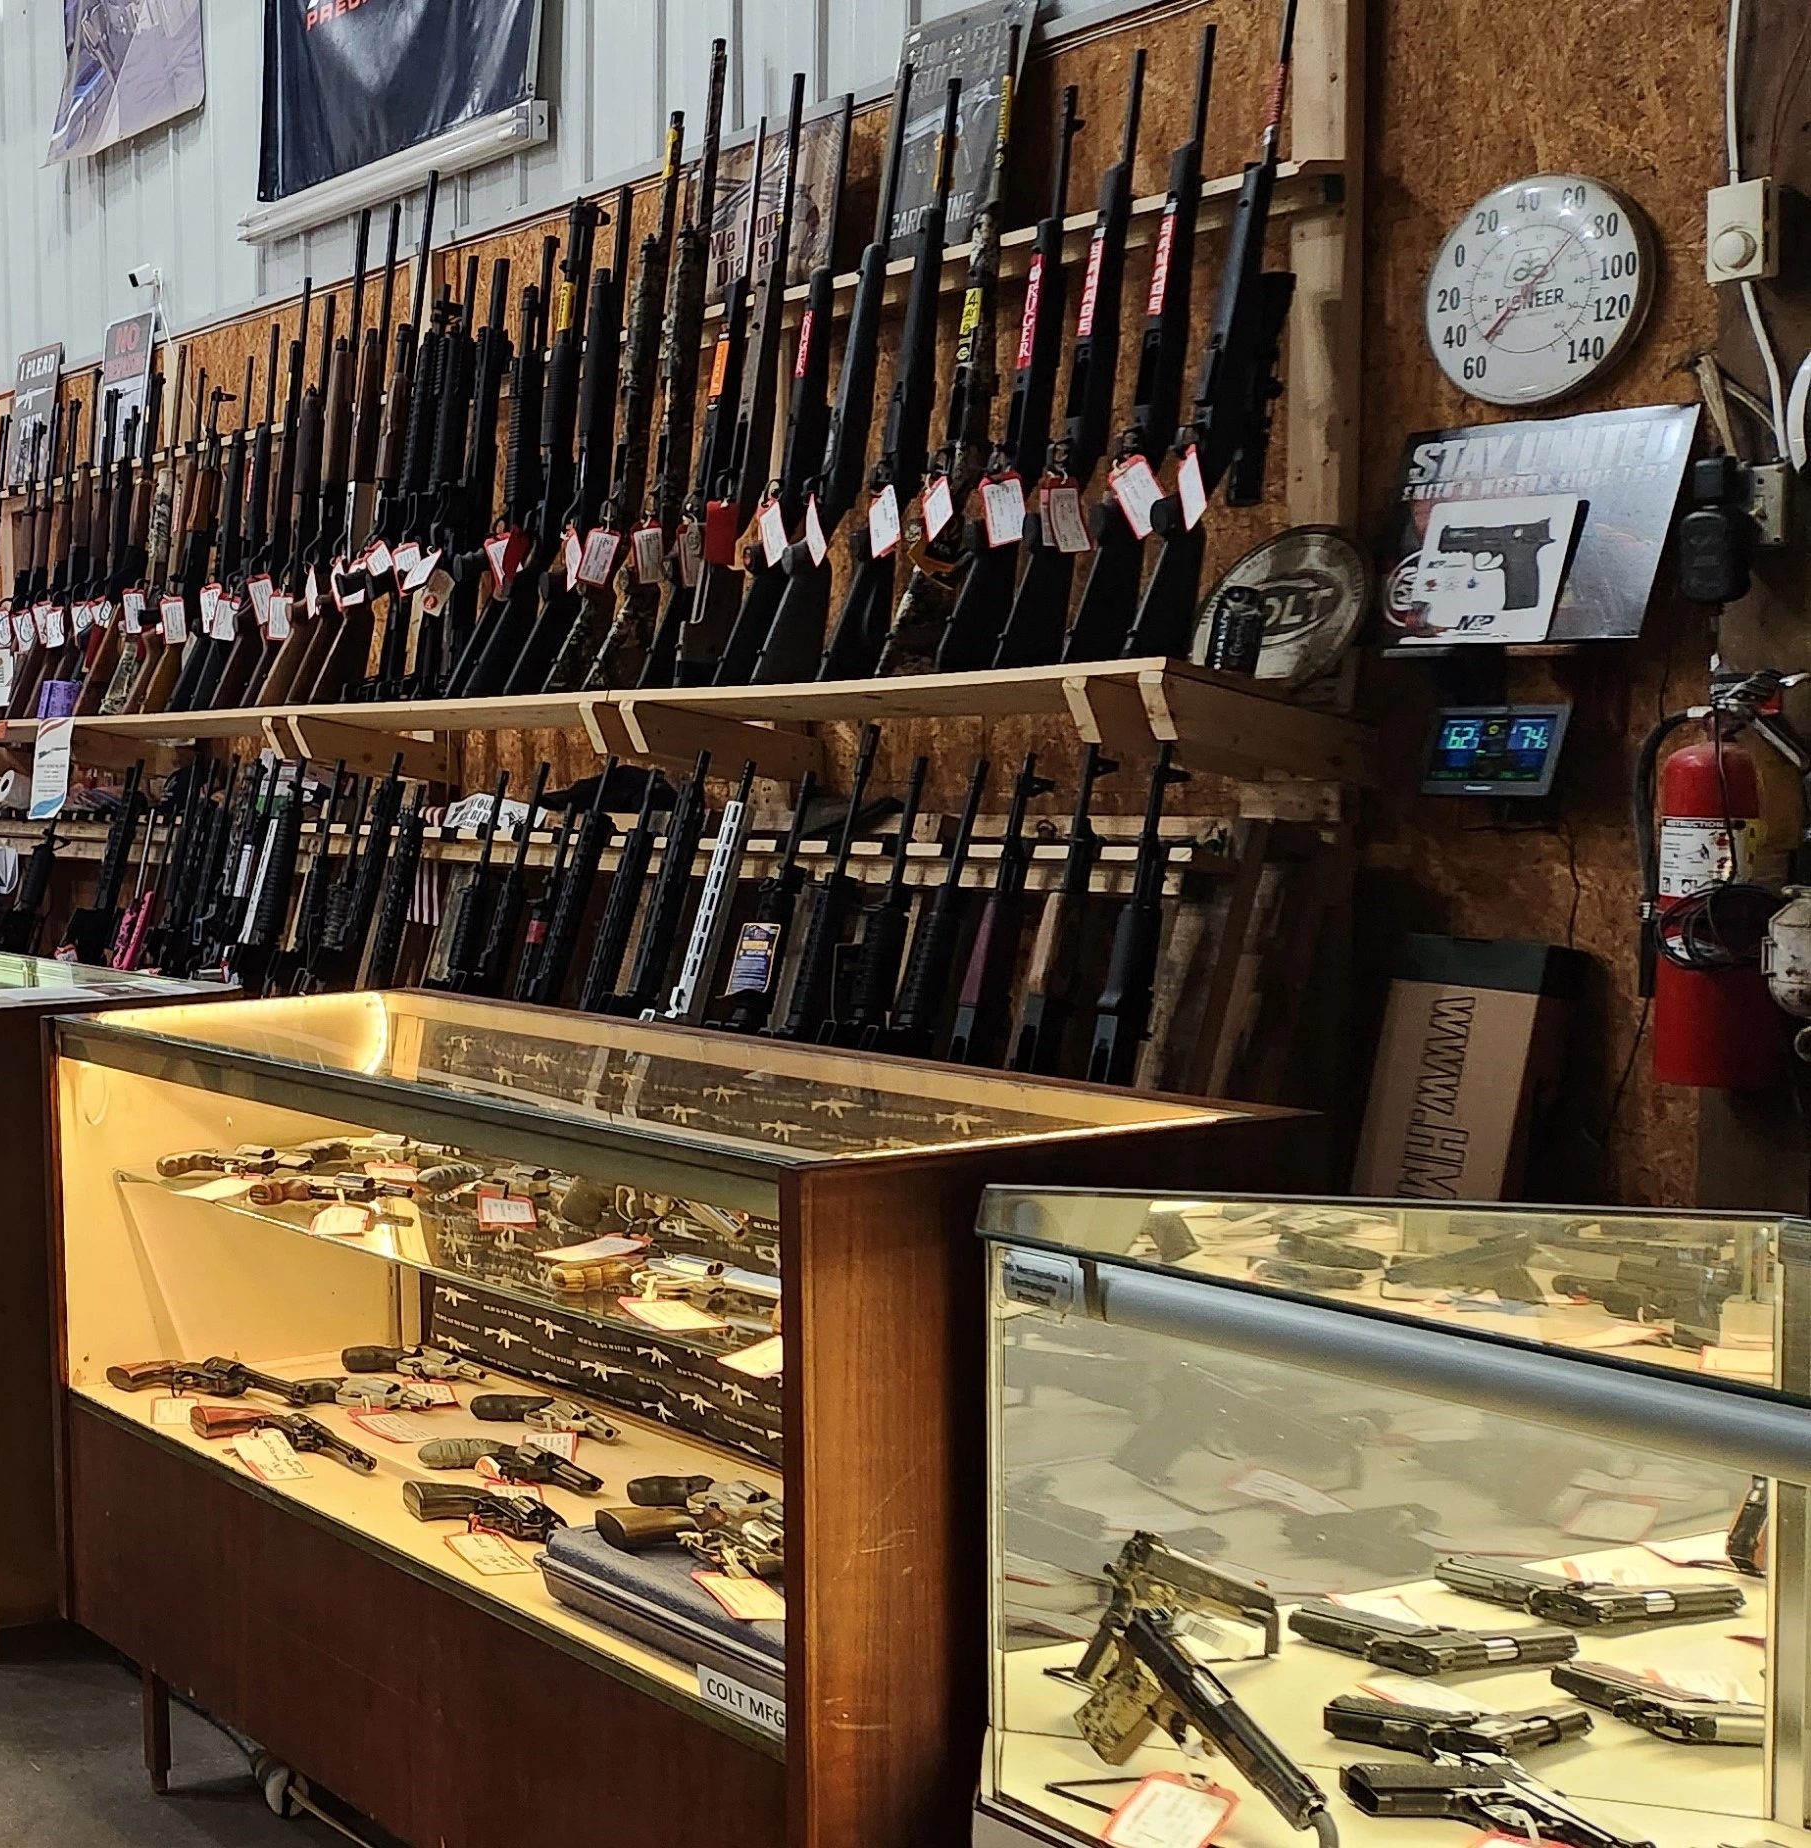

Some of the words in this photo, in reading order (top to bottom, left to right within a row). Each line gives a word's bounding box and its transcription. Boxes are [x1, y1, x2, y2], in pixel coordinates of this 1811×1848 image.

[1516, 189, 1541, 212] 40
[1562, 185, 1586, 210] 60
[890, 202, 934, 240] CAR
[1475, 209, 1499, 235] 20
[1593, 212, 1619, 240] 80
[1454, 244, 1465, 267] 0
[1599, 251, 1637, 281] 100
[716, 256, 745, 288] Dia
[1437, 287, 1461, 313] 20
[1593, 293, 1631, 323] 120
[114, 322, 141, 355] NO
[1442, 323, 1467, 349] 40
[1567, 336, 1605, 364] 140
[25, 353, 56, 381] PLEAD
[1463, 355, 1487, 380] 60
[1410, 438, 1513, 483] STAY
[1517, 420, 1683, 475] UNITED
[1265, 587, 1335, 627] OLT
[706, 1678, 745, 1709] COLT
[749, 1697, 785, 1728] MFG
